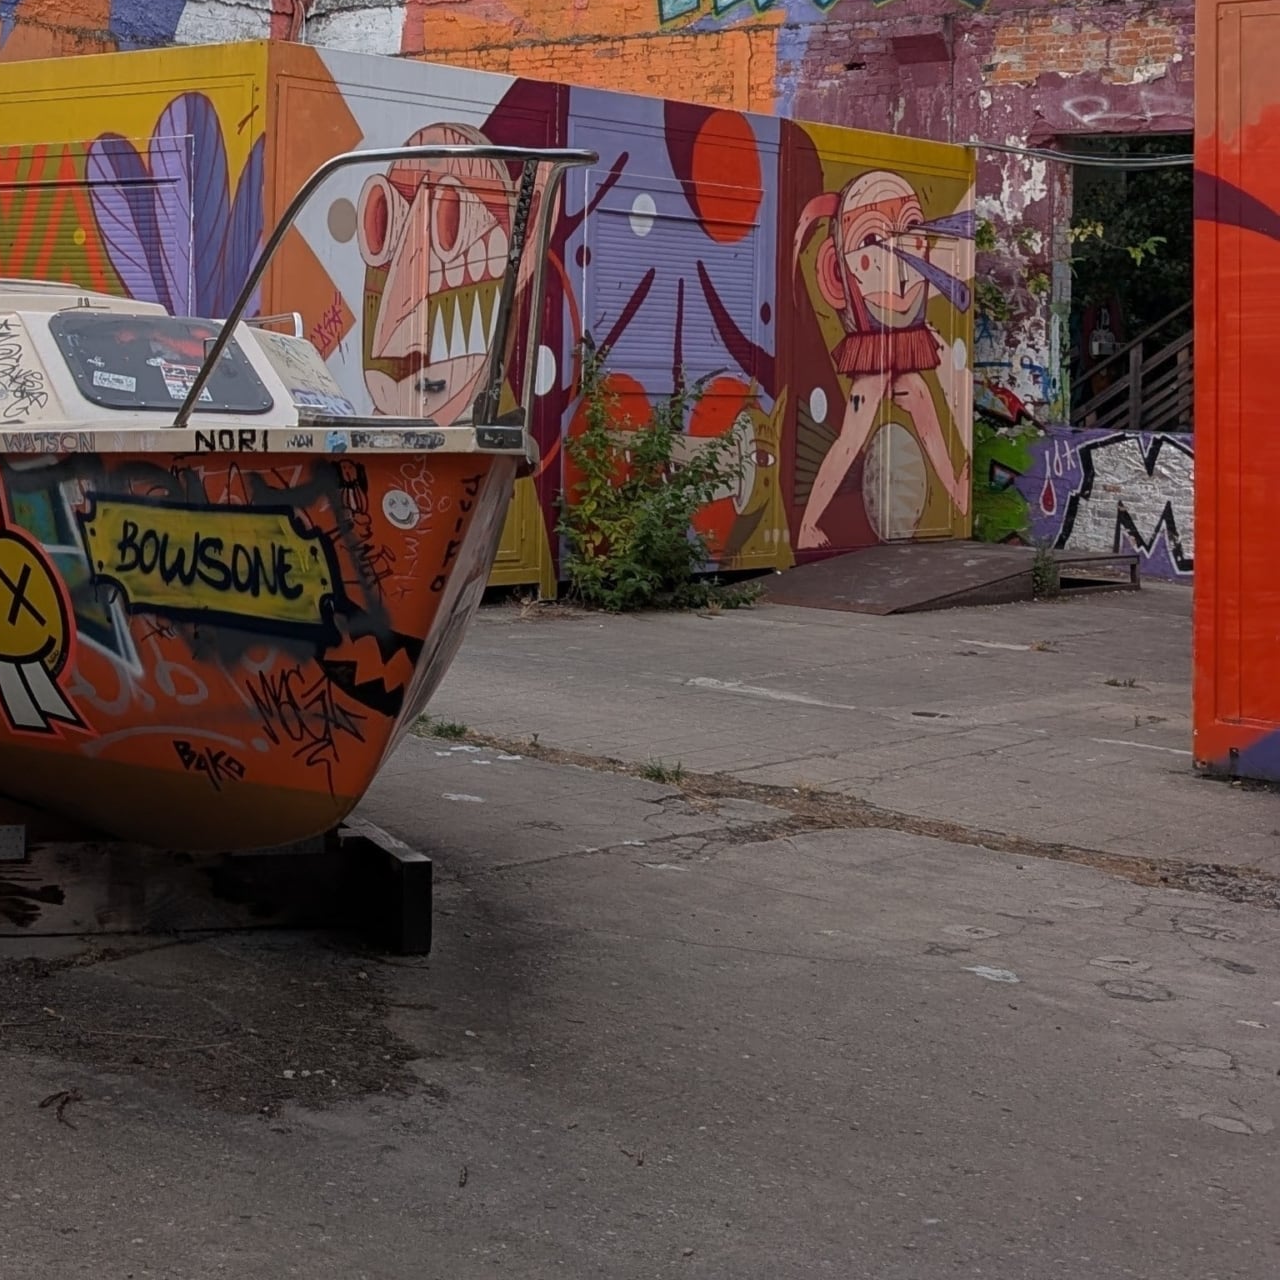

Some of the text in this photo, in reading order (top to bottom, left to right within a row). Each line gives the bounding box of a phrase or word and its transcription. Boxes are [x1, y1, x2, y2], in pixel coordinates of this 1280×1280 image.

[2, 431, 96, 453] WATSON
[195, 429, 269, 453] NORI
[115, 519, 304, 601] BOWSONE
